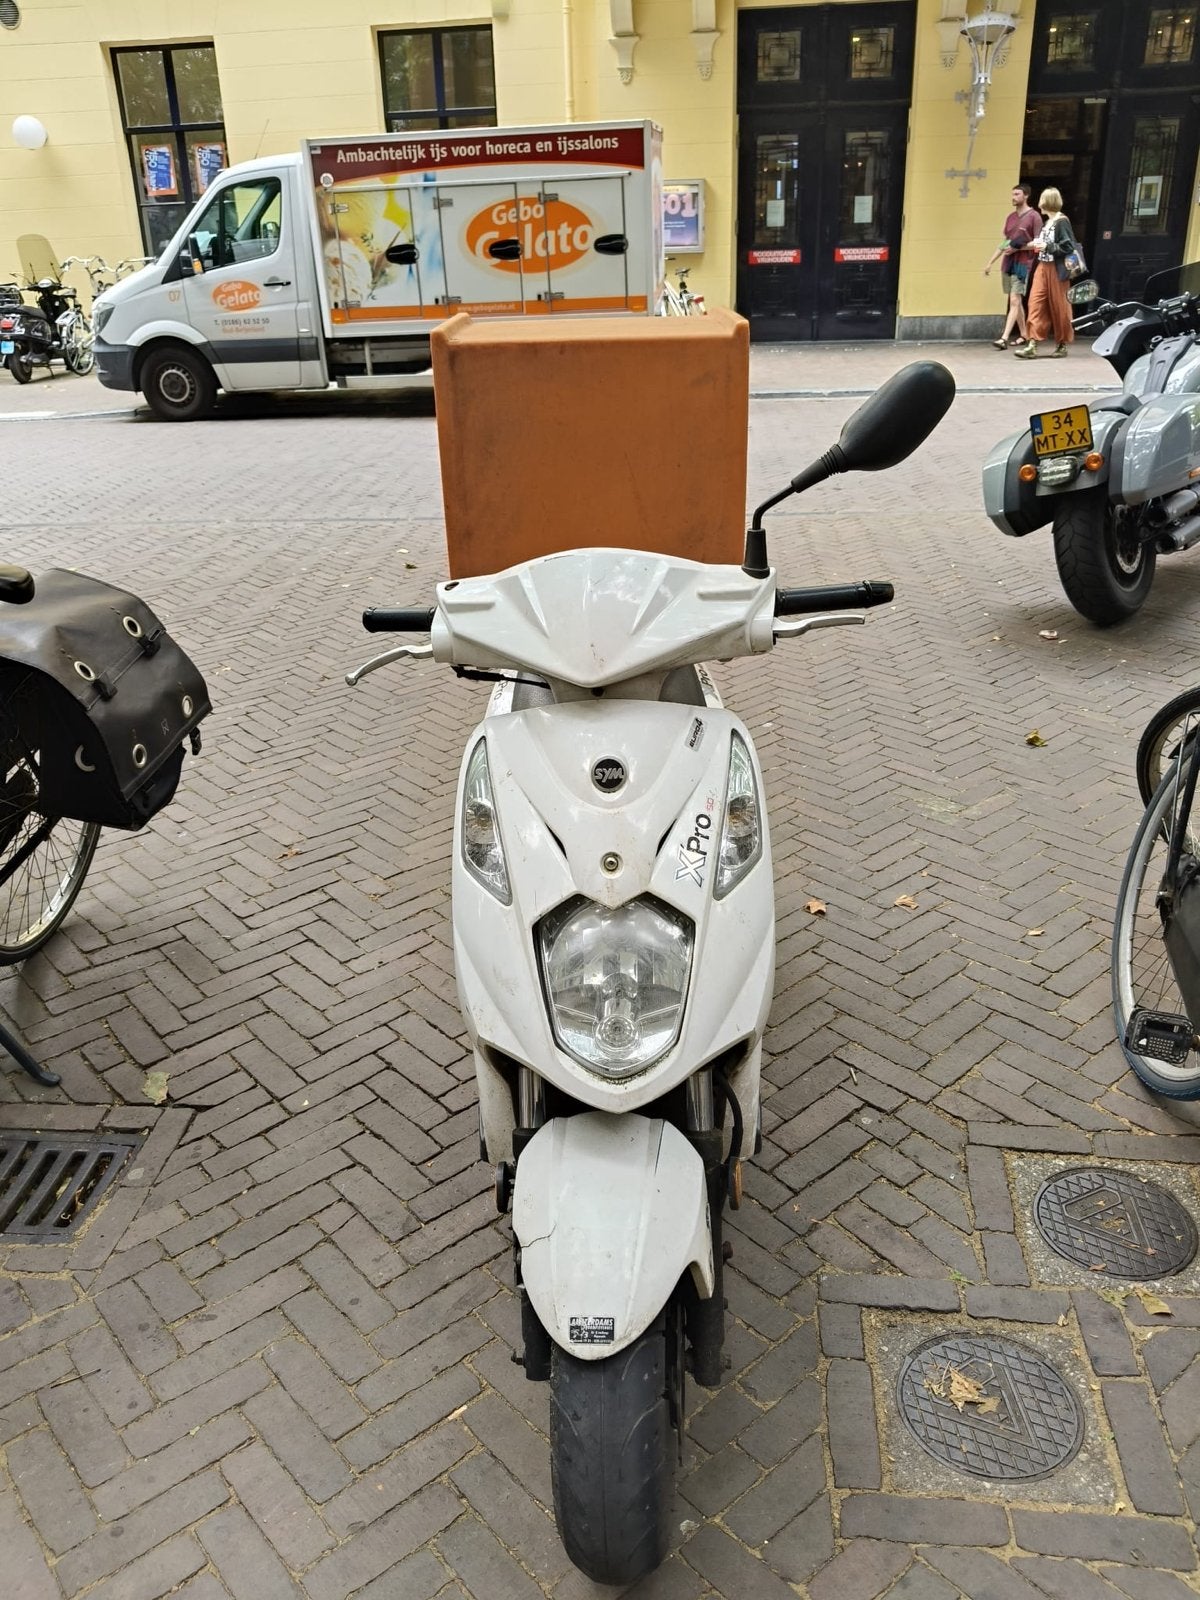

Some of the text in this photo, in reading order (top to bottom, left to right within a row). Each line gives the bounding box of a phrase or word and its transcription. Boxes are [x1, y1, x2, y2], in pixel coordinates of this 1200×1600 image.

[337, 136, 619, 163] Ambachtelijk ijs voor horeca en ijssalons
[491, 200, 545, 225] Gebo
[664, 192, 698, 217] 01
[475, 222, 594, 266] Glato
[168, 290, 180, 302] 07
[216, 289, 261, 307] Gelato
[1052, 412, 1073, 430] 34
[1036, 428, 1089, 452] MT-XX
[595, 767, 624, 783] SYM
